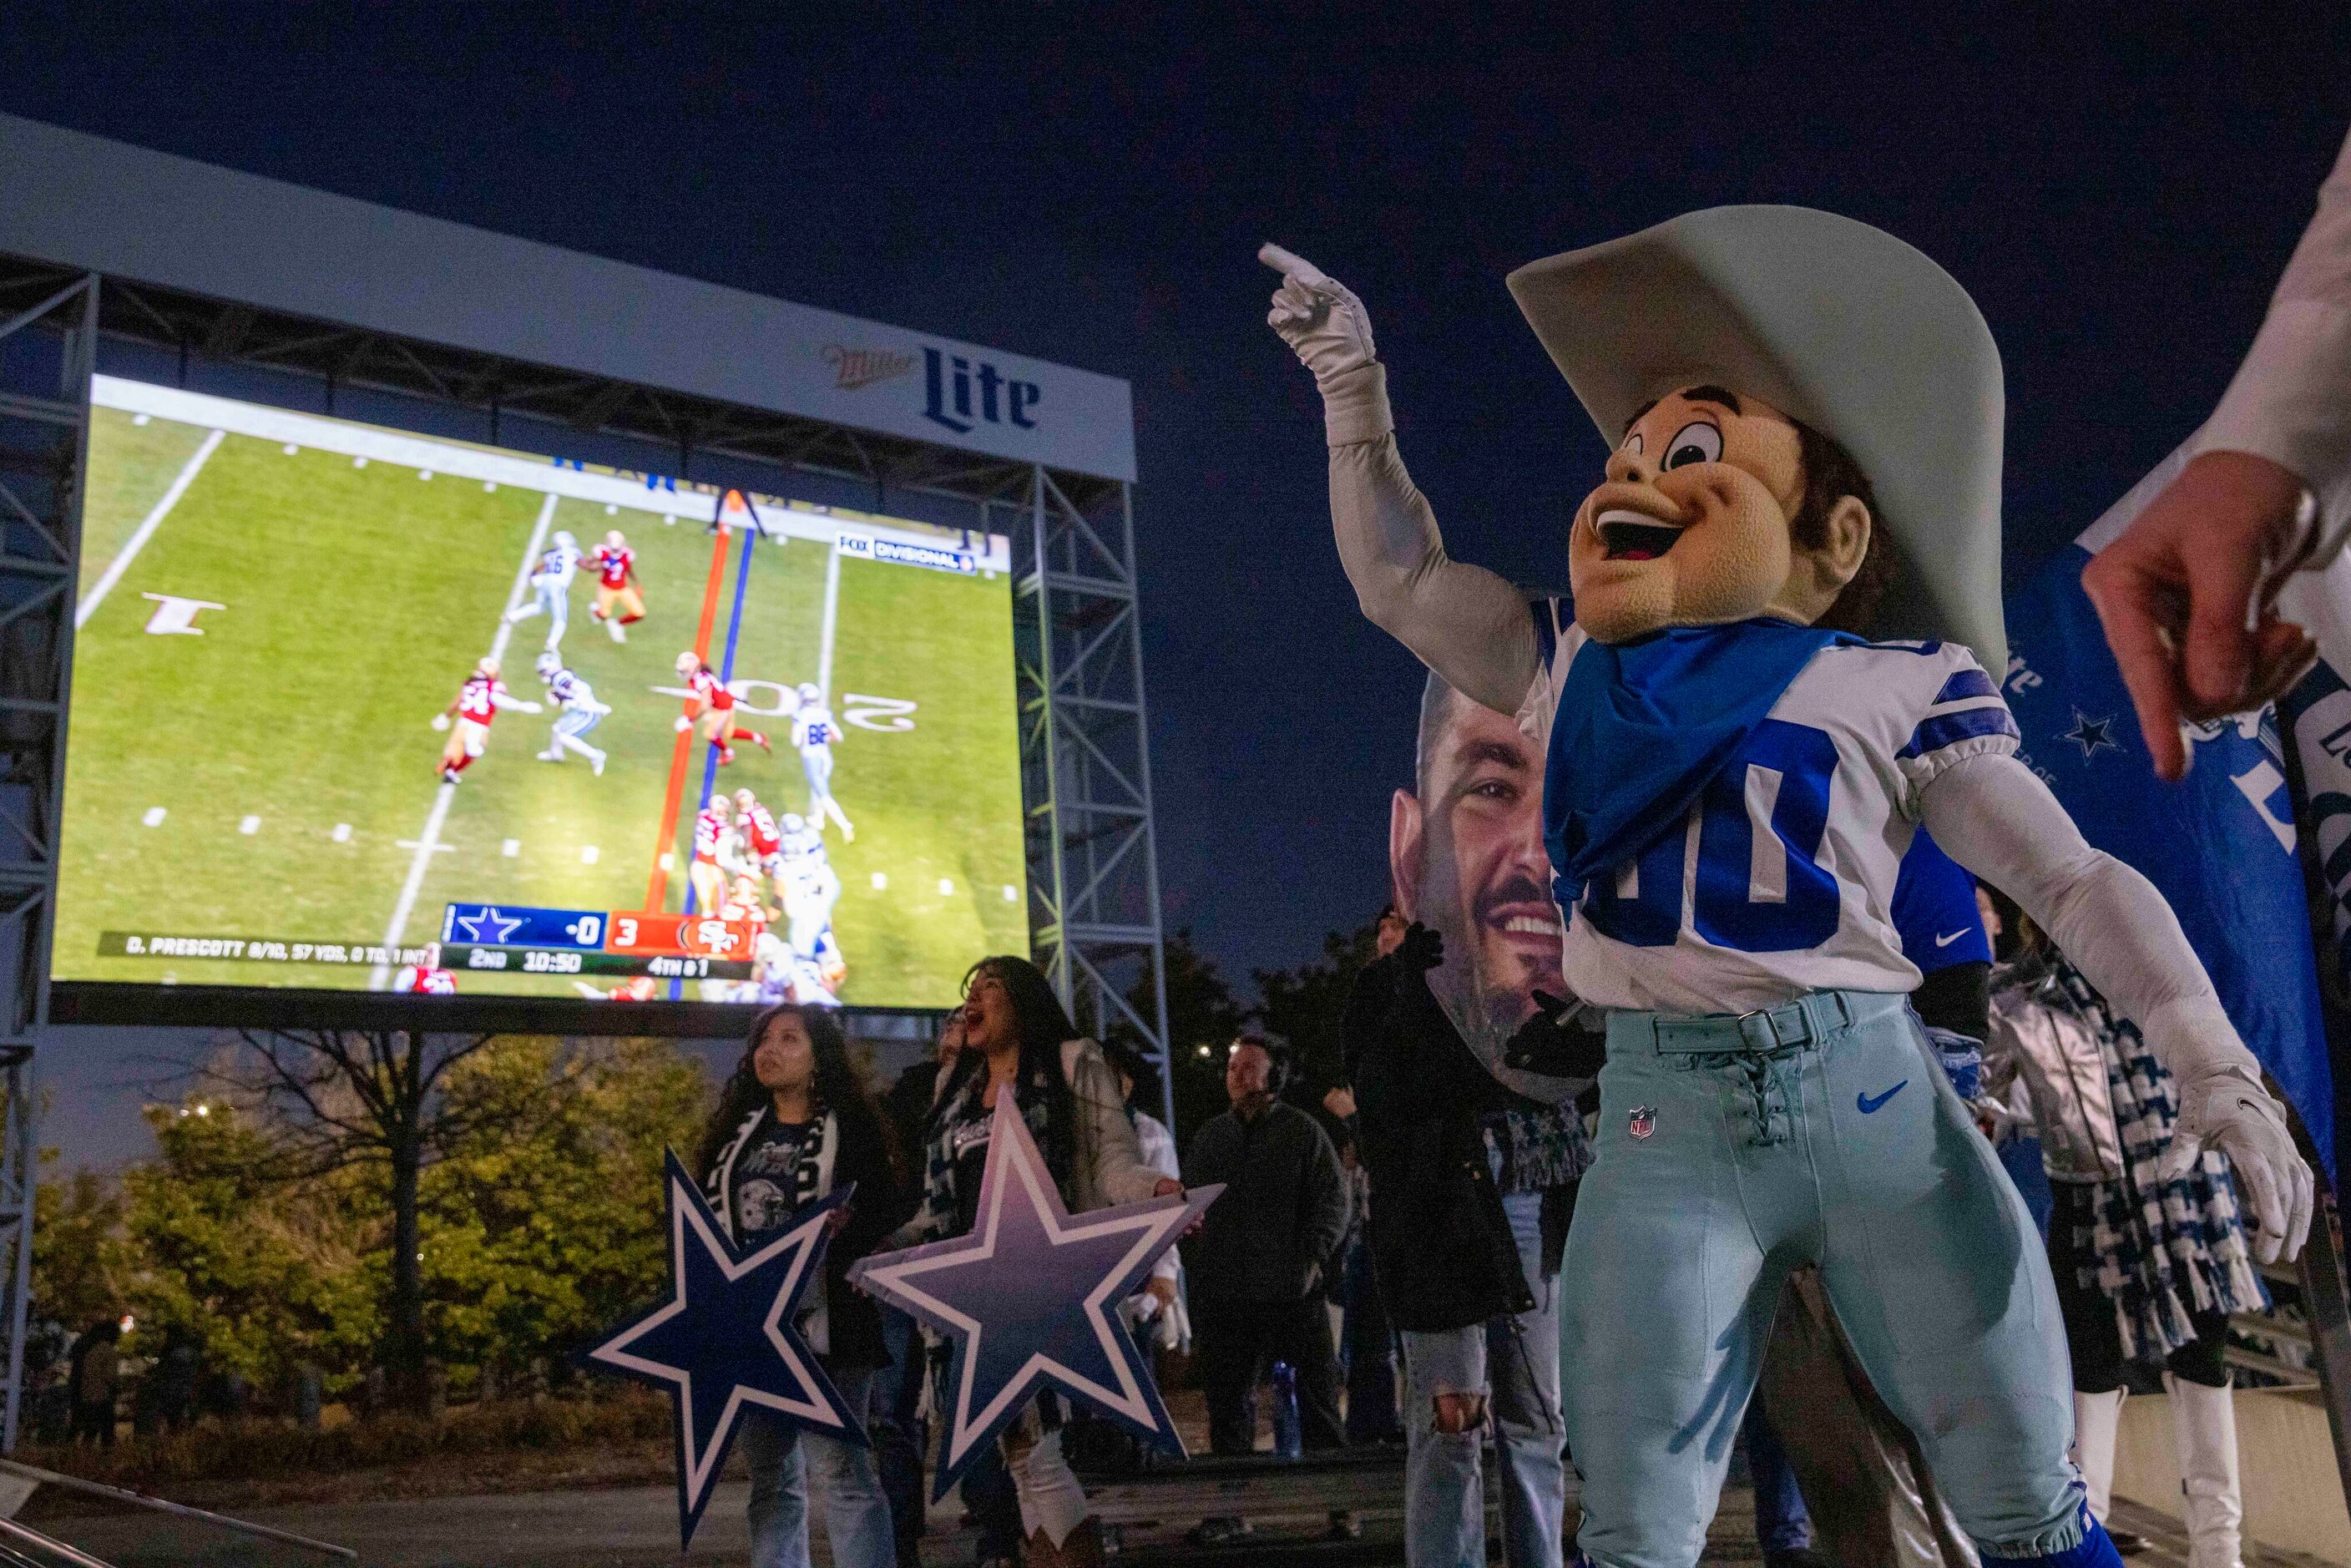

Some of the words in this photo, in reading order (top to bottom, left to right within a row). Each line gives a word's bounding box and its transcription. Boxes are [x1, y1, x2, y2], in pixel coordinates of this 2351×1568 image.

[820, 344, 915, 391] Miller
[922, 346, 1041, 432] Lite
[841, 536, 869, 553] FOX
[877, 543, 959, 569] DIVISIONAL
[575, 916, 601, 946] 0
[614, 918, 639, 947] 3
[125, 936, 145, 955] D.
[149, 938, 245, 958] PRESCOTT
[292, 943, 315, 960] 57
[314, 944, 348, 964] YDS,
[351, 946, 364, 963] 0
[366, 947, 389, 964] TD,
[392, 948, 401, 964] 1
[401, 948, 427, 965] INT
[468, 948, 508, 969] 2ND
[523, 951, 582, 974] 10:50
[648, 956, 682, 976] 4TH
[683, 959, 698, 977] &
[698, 958, 709, 977] 1
